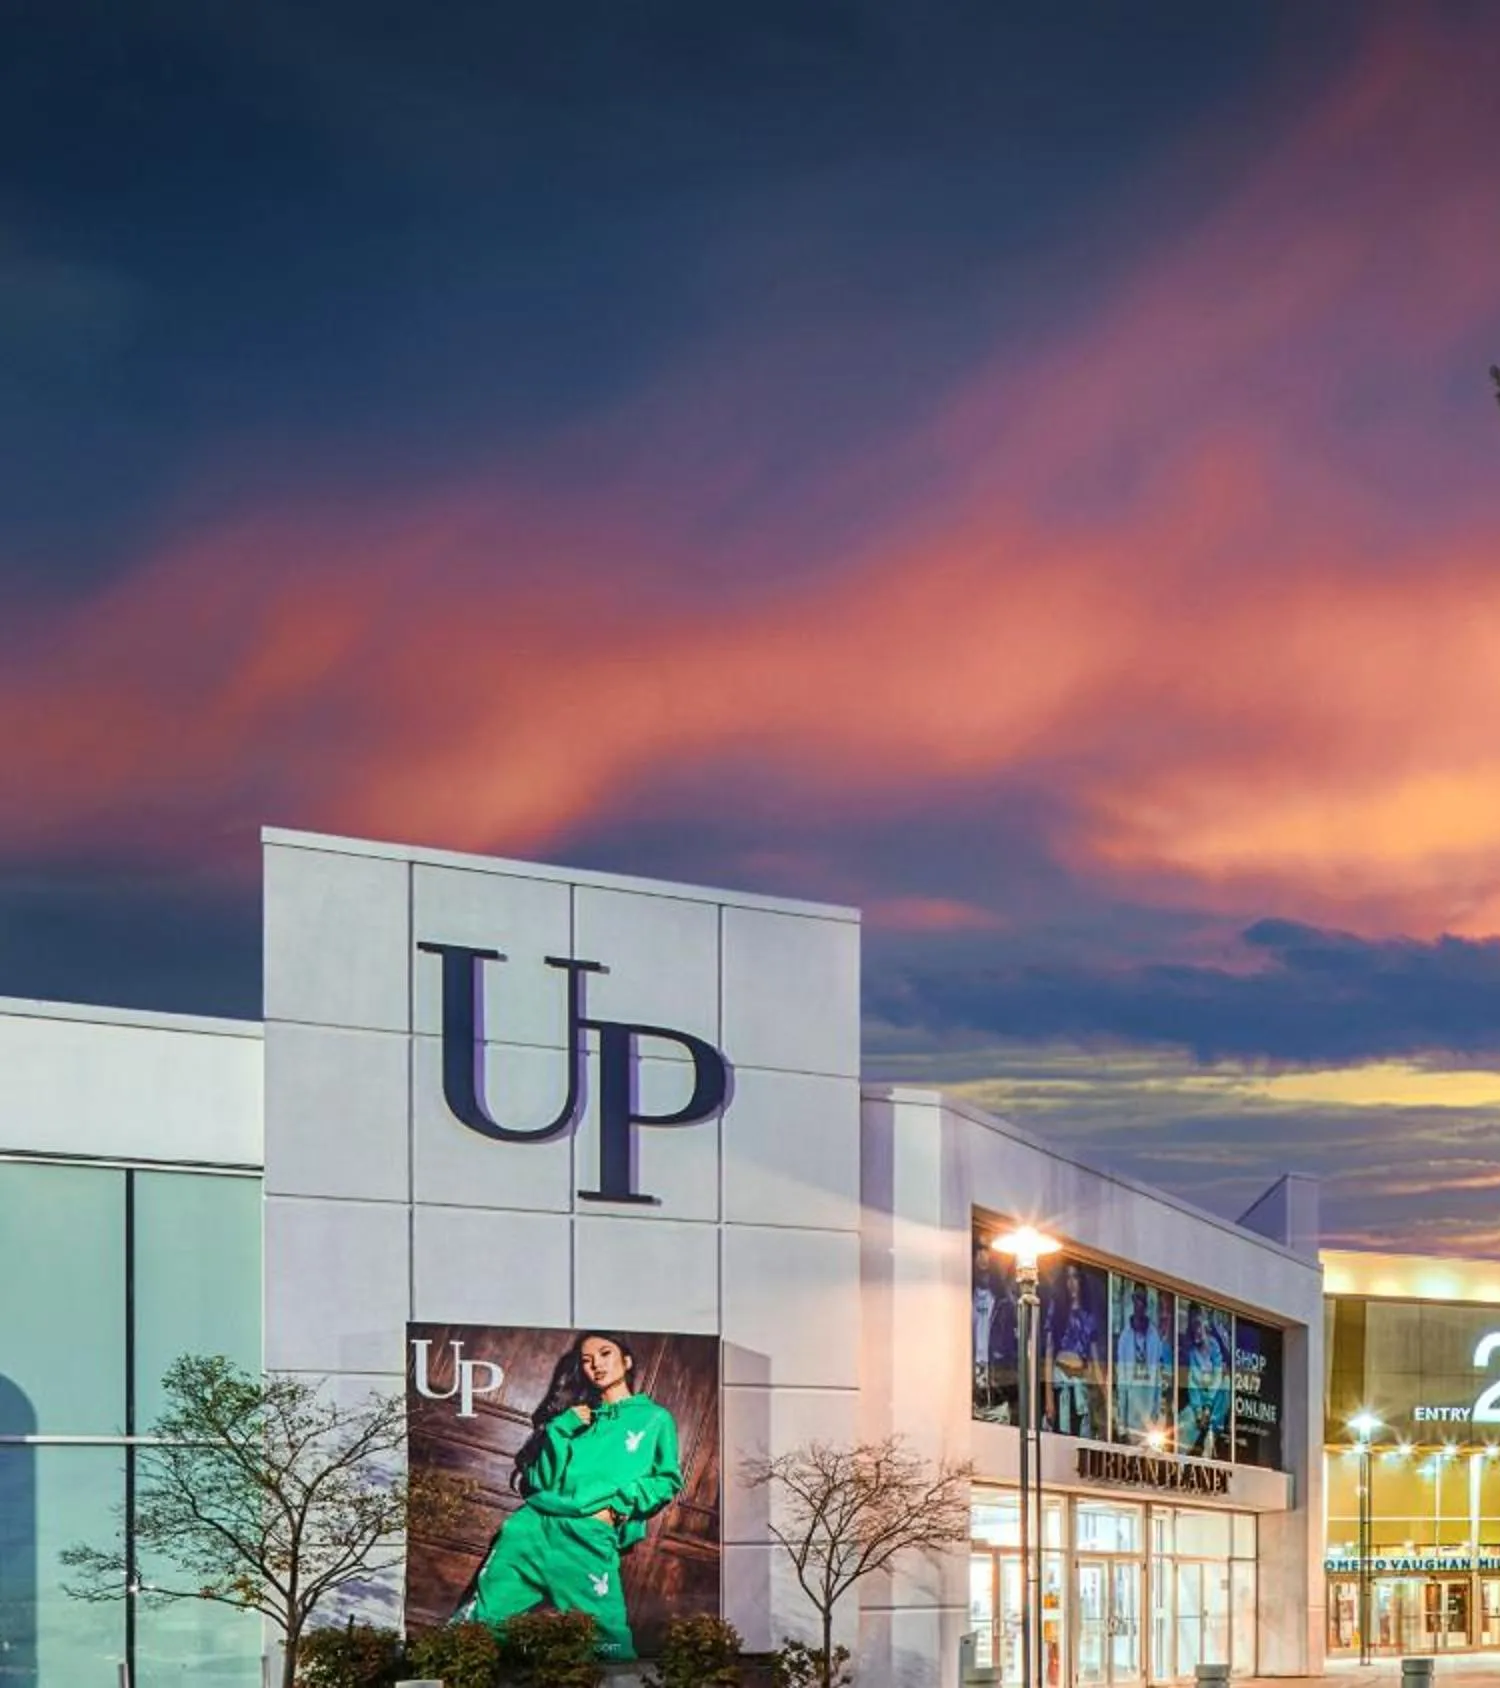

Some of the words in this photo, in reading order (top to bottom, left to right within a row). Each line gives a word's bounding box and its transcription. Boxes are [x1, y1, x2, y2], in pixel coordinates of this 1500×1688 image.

[416, 941, 736, 1206] UP
[1235, 1348, 1267, 1373] SHOP
[410, 1339, 504, 1417] UP
[1235, 1373, 1262, 1393] 24/7
[1235, 1397, 1278, 1422] ONLINE
[1414, 1407, 1471, 1421] ENTRY
[1076, 1448, 1160, 1487] URBAN
[1161, 1459, 1233, 1495] PLANET
[1391, 1558, 1471, 1570] VAUGHAN
